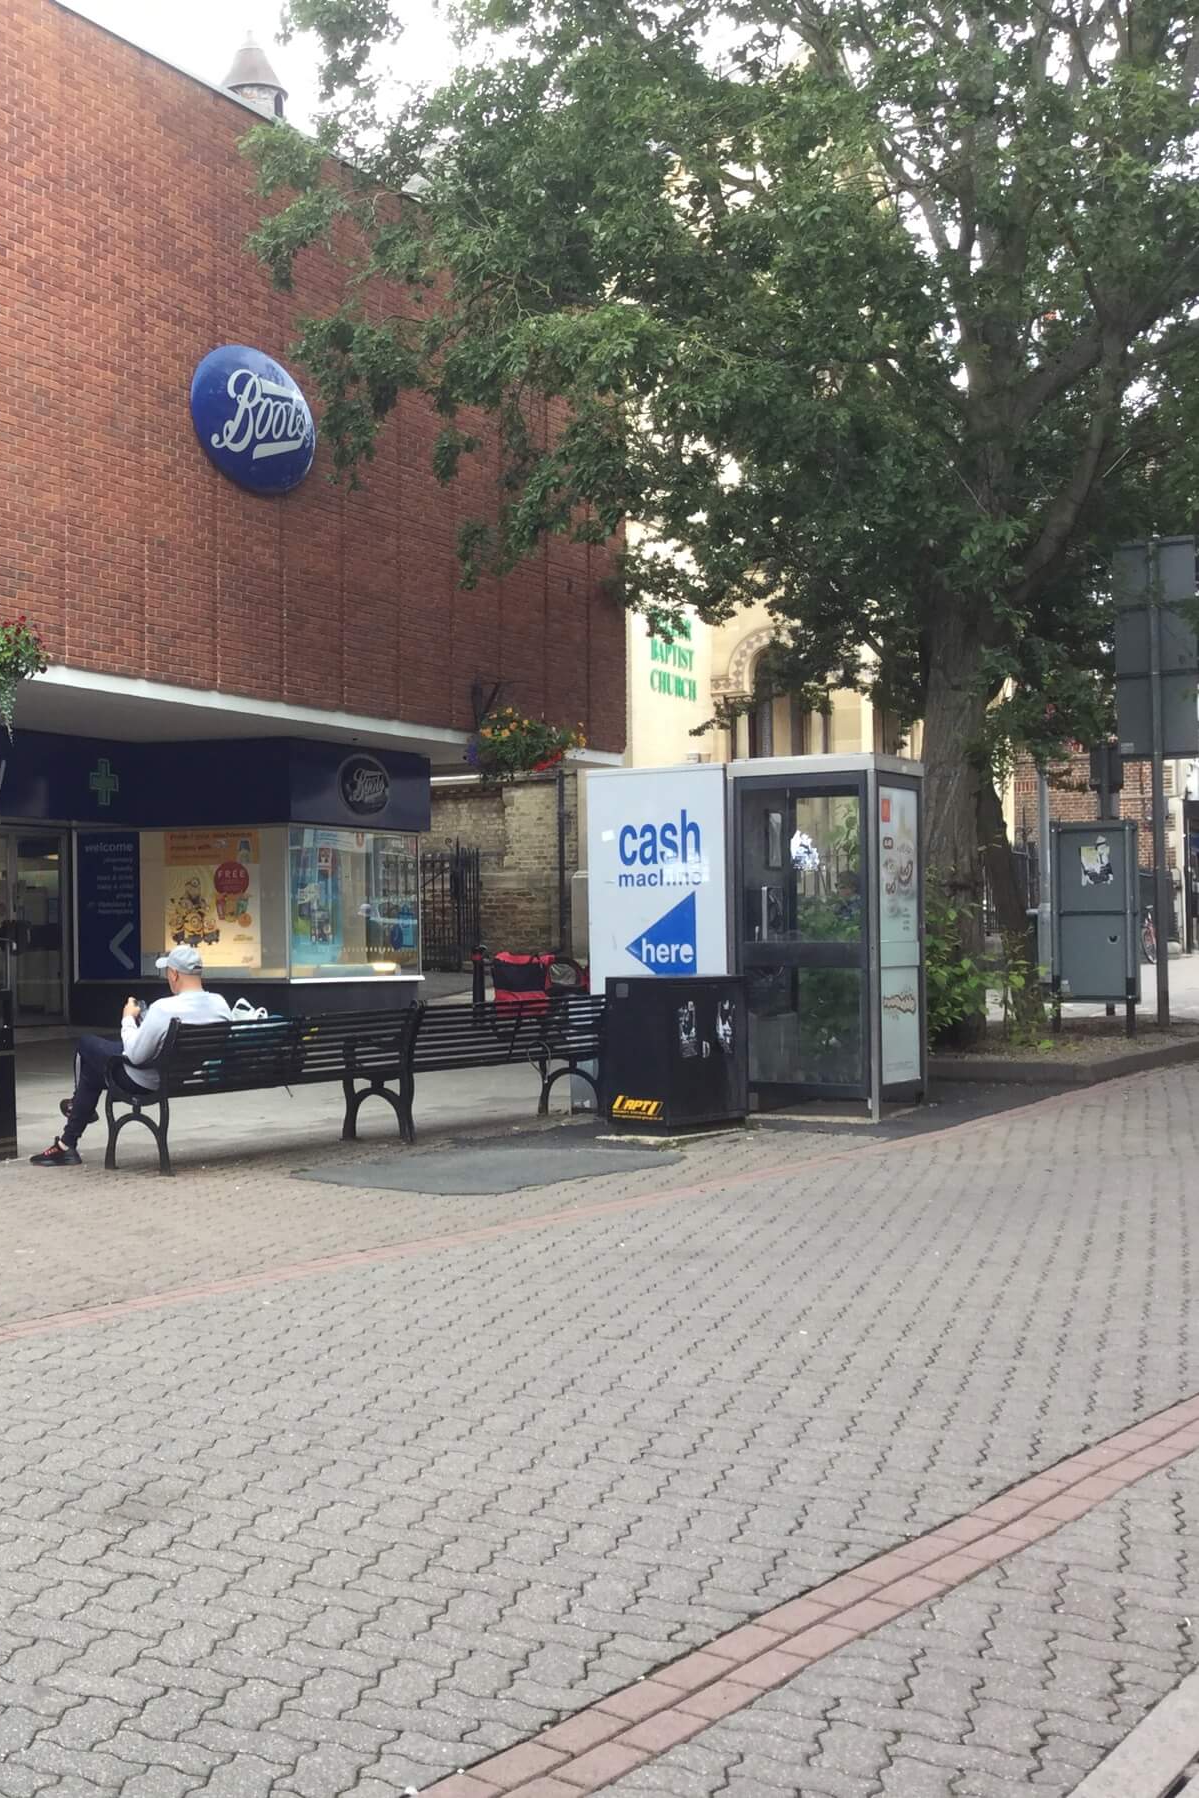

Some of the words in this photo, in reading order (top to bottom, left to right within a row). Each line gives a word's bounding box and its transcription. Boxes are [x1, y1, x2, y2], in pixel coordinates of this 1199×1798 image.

[211, 369, 307, 460] Boots
[651, 638, 694, 672] BAPTIST
[649, 668, 697, 703] CHURCH
[619, 809, 701, 867] cash
[217, 869, 246, 879] FREE
[618, 868, 702, 888] mach
[641, 938, 694, 964] here
